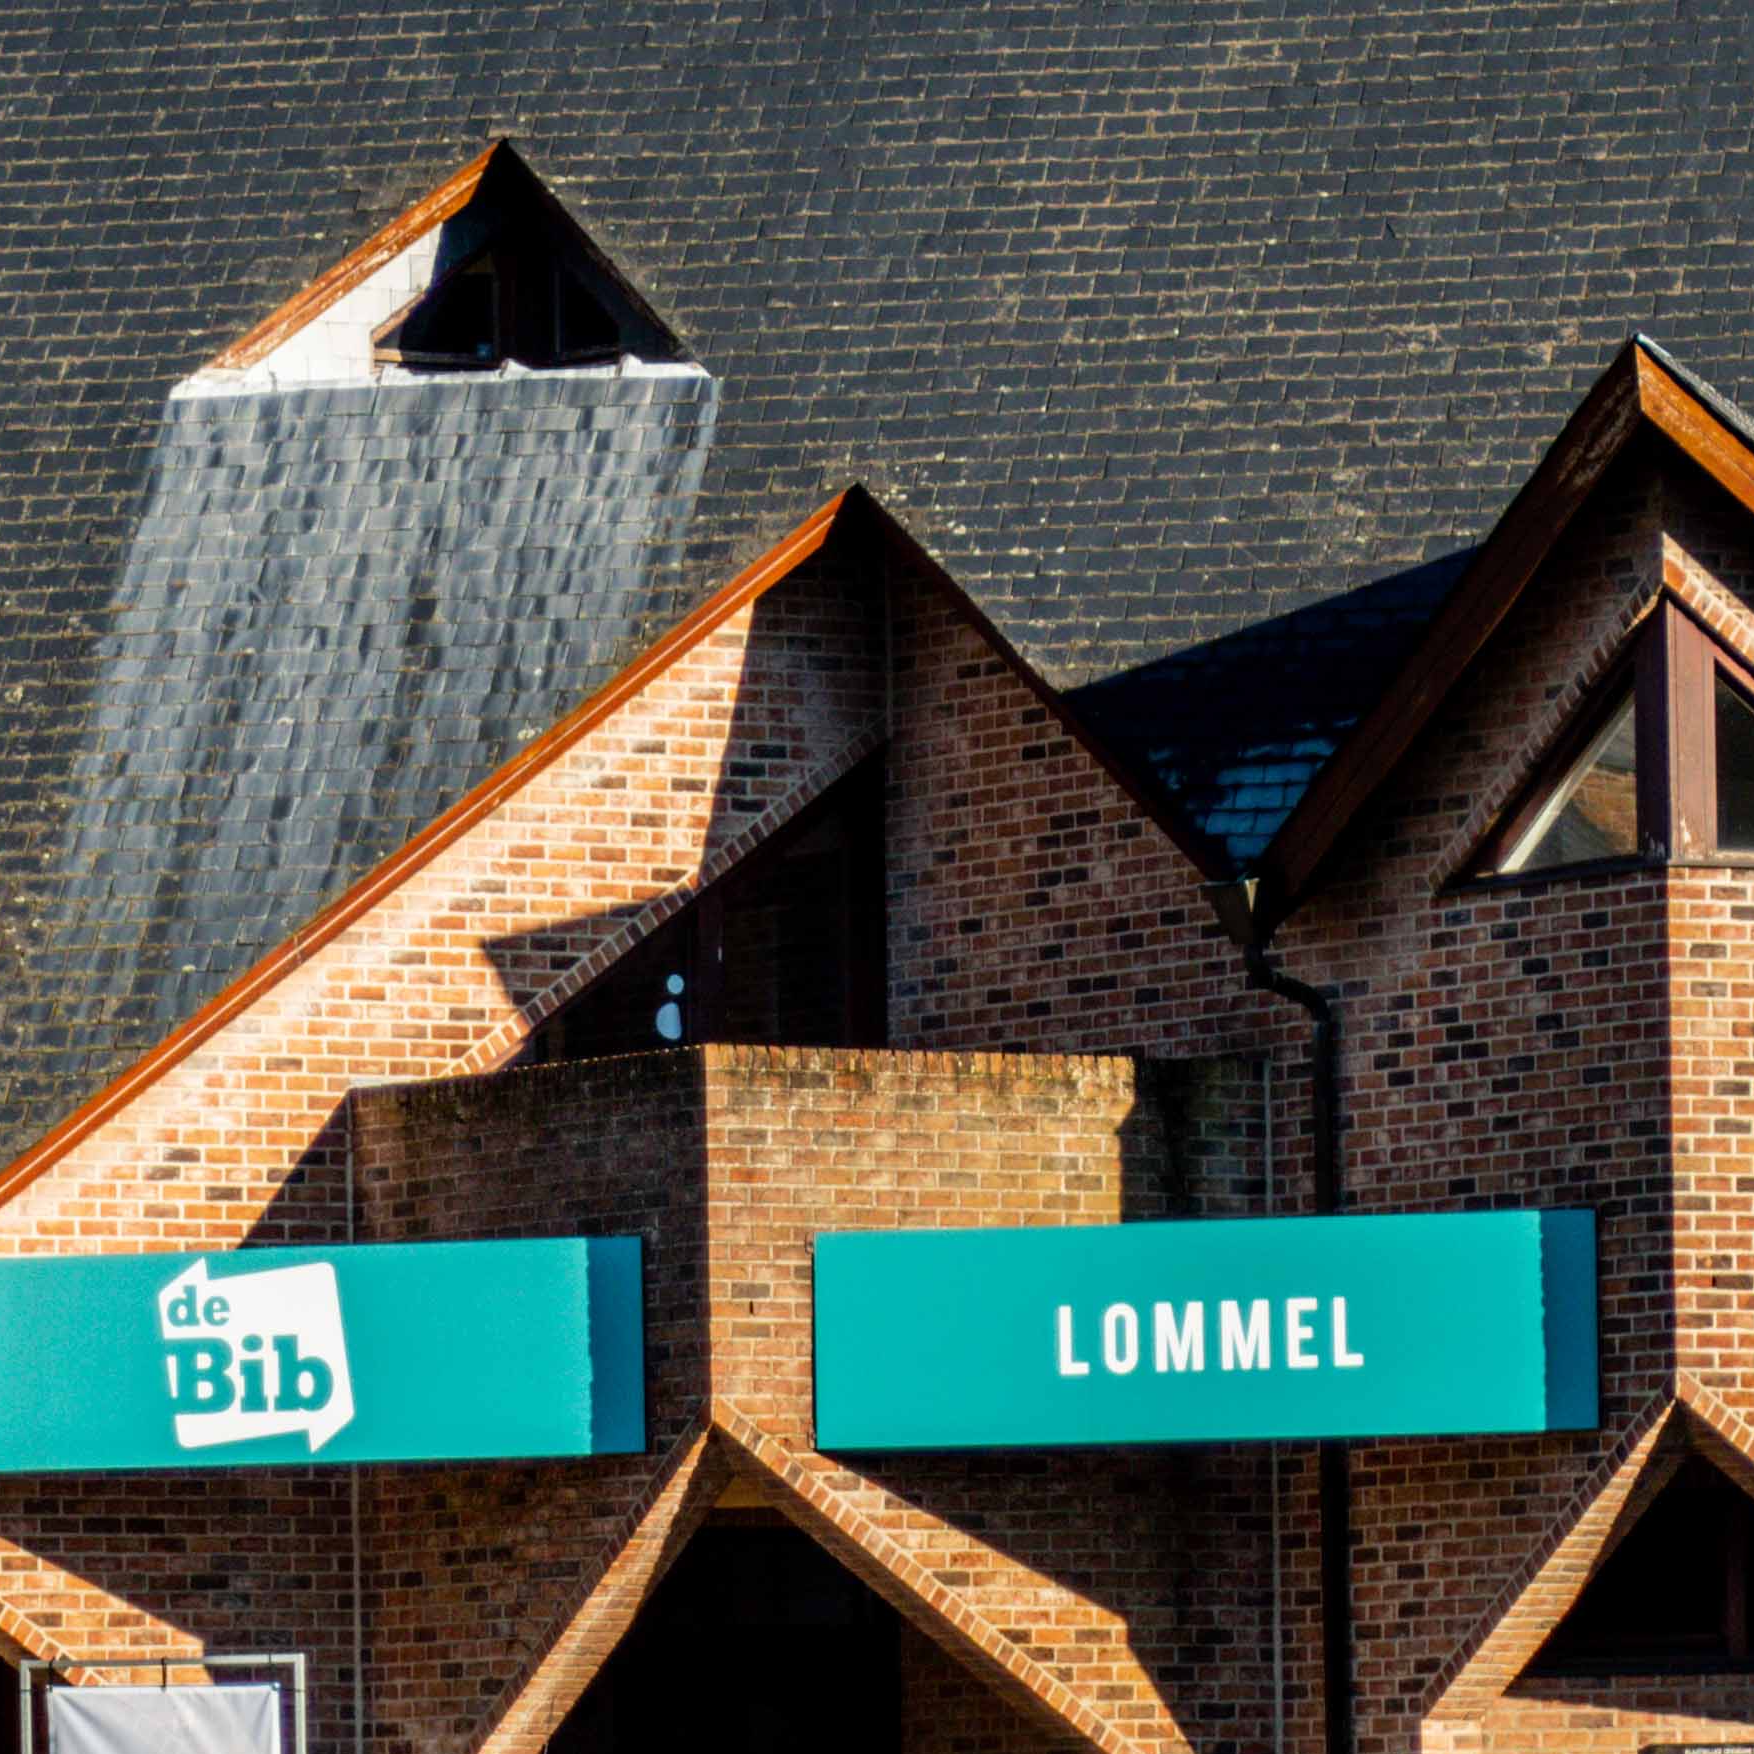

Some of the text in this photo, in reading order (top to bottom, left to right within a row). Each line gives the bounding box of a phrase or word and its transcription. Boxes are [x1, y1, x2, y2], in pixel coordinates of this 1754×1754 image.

[166, 1285, 230, 1327] de
[1056, 1296, 1365, 1378] LOMMEL
[164, 1333, 333, 1416] Bib
